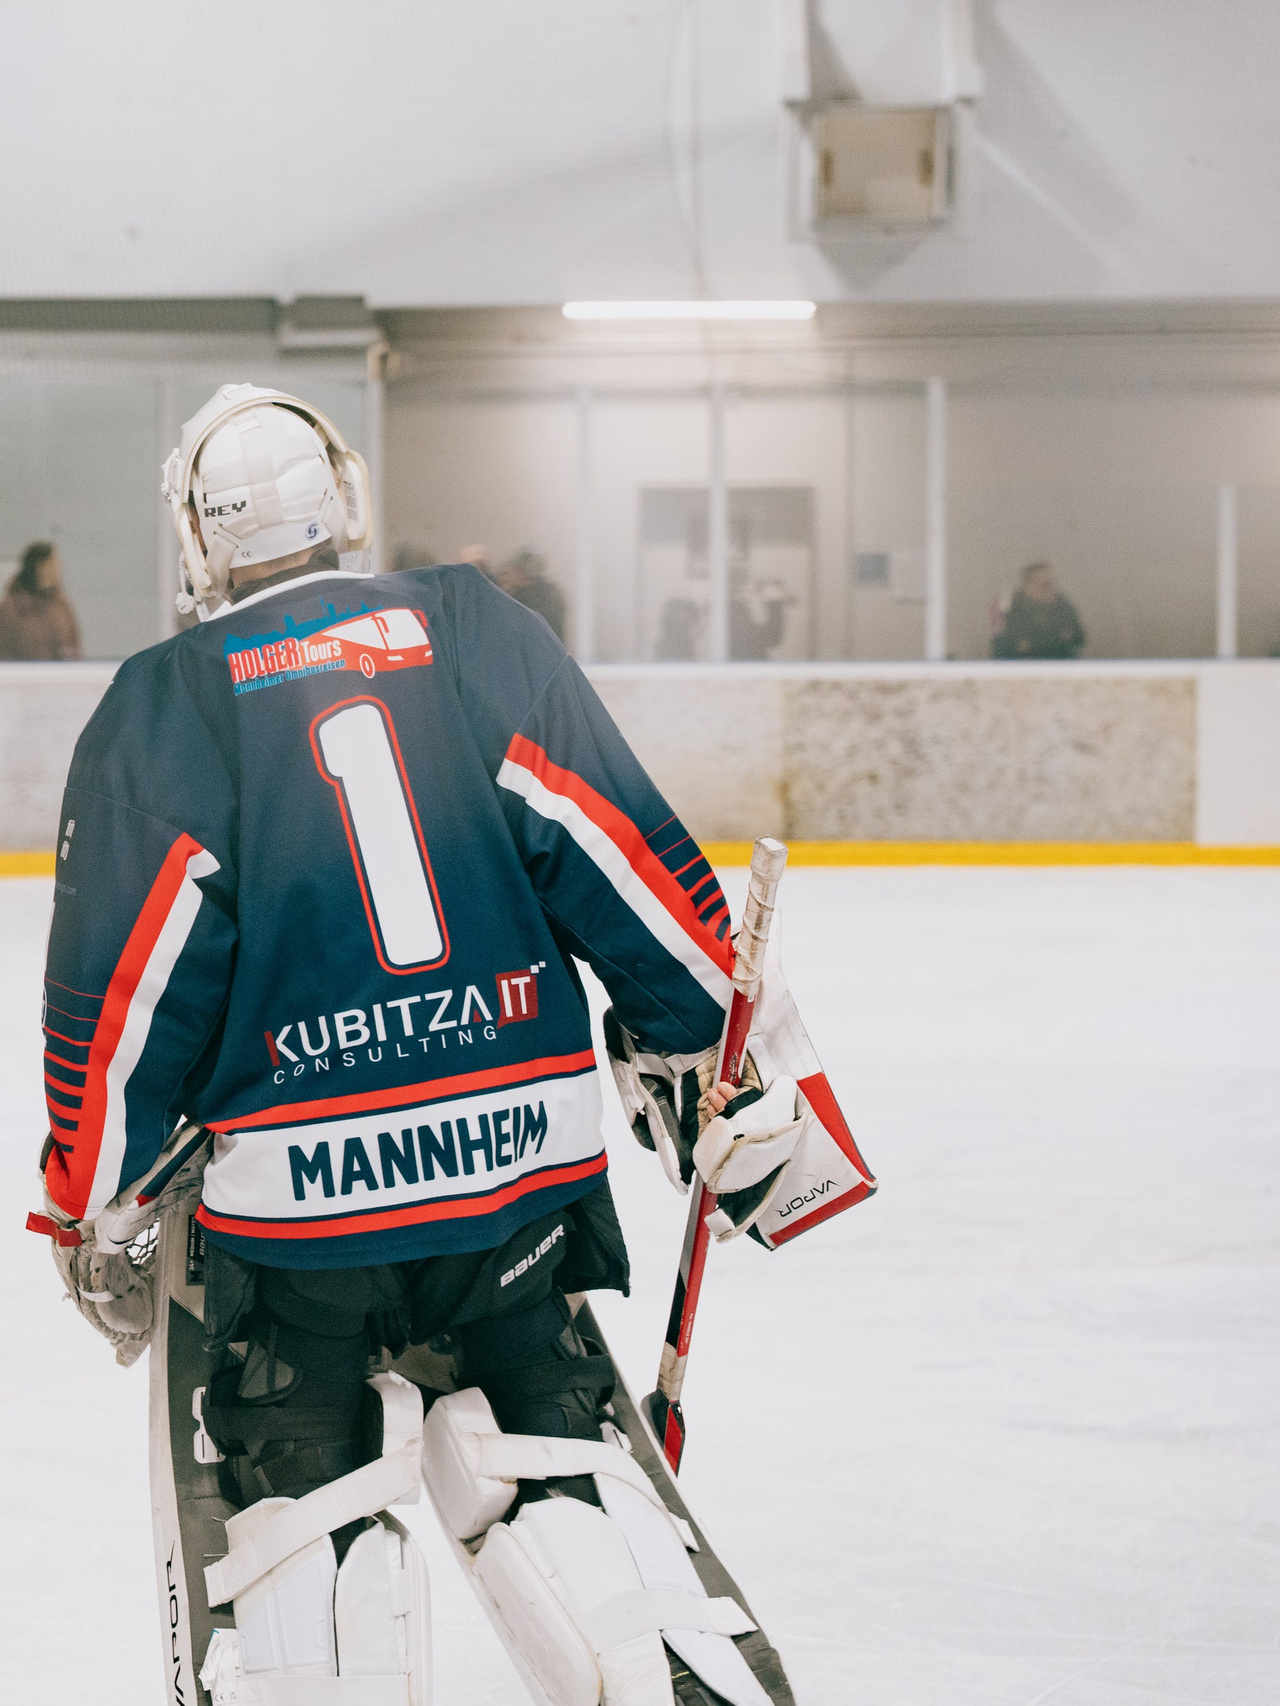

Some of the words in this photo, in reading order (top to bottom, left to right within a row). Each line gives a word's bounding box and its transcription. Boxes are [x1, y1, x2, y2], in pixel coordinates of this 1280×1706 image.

[204, 500, 246, 518] REY
[227, 637, 302, 684] HOLGER
[301, 640, 342, 663] Tours
[233, 672, 285, 696] Mannheimer
[285, 659, 346, 681] Omnibusreisen
[309, 695, 450, 976] 1
[264, 984, 494, 1067] KUBITZA
[500, 975, 531, 1019] IT
[273, 1025, 498, 1085] CONSULTING
[287, 1100, 549, 1202] MANNHEIM
[775, 1180, 841, 1218] VAPOR
[500, 1224, 566, 1288] BAUER
